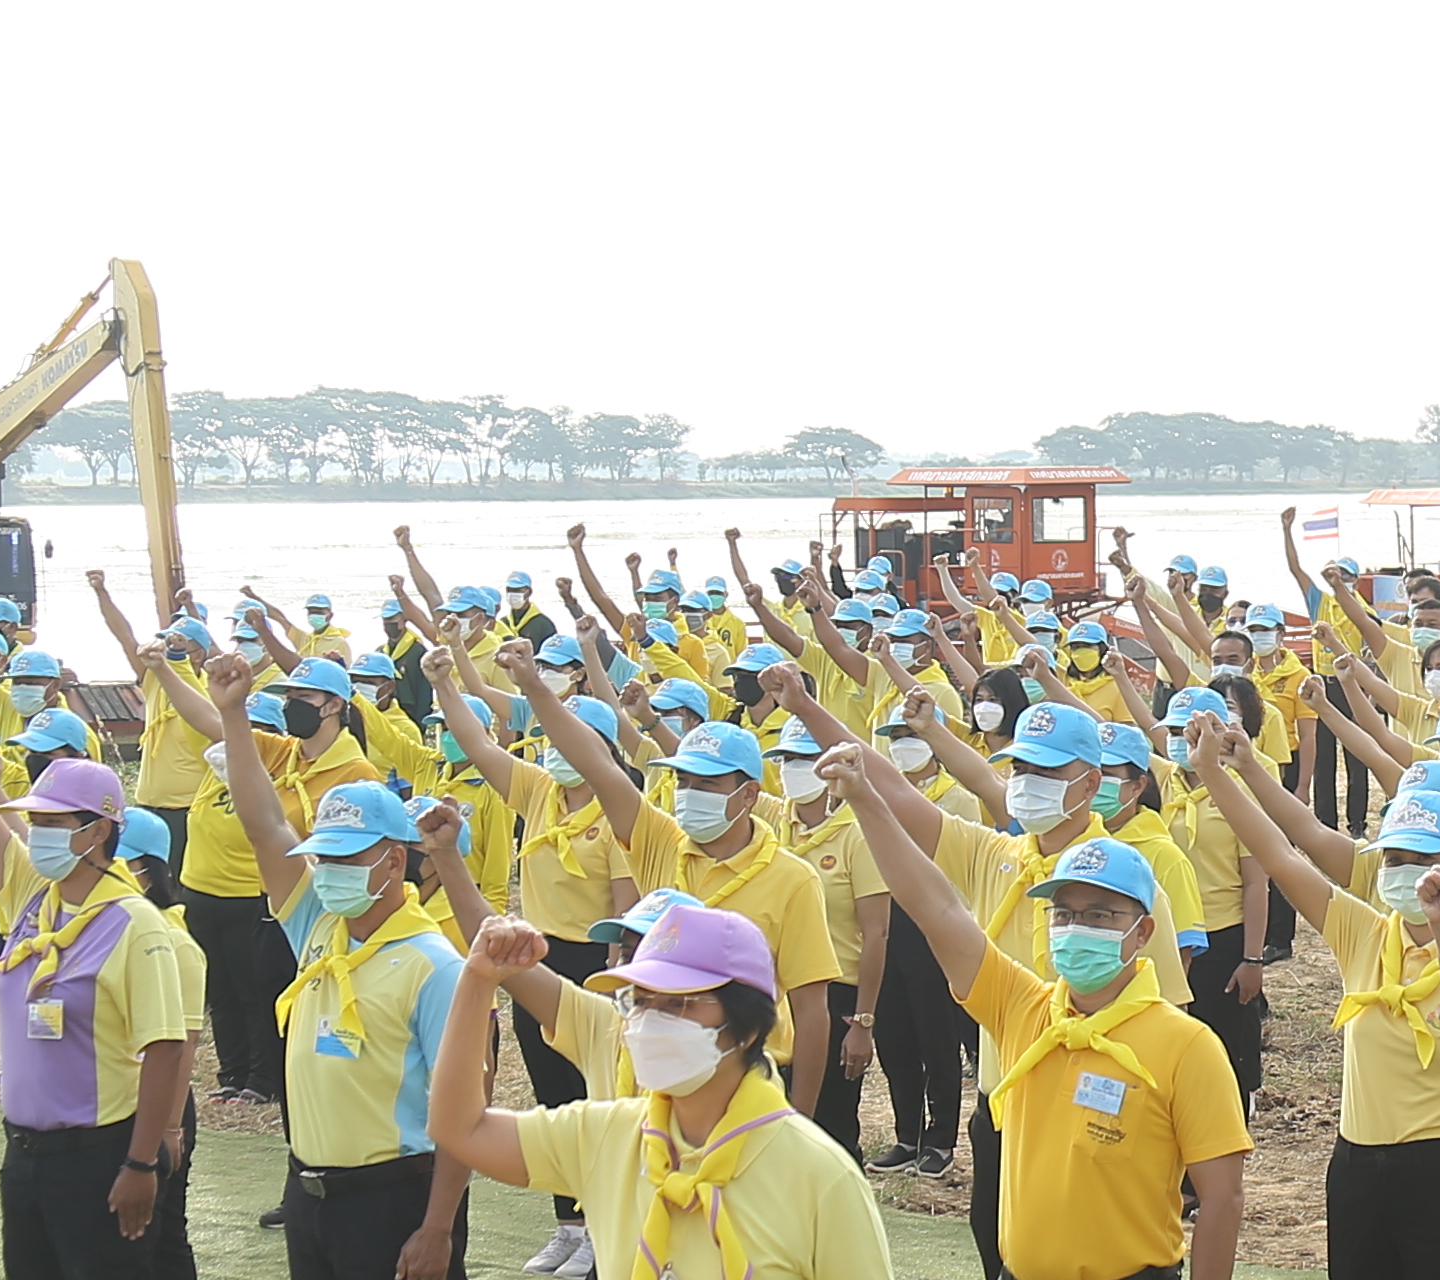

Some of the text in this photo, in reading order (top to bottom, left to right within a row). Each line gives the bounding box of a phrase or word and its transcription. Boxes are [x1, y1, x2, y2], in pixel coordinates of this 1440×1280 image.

[41, 339, 89, 390] KOMATSU
[907, 470, 1011, 482] เทศบาลนครสกลนคร
